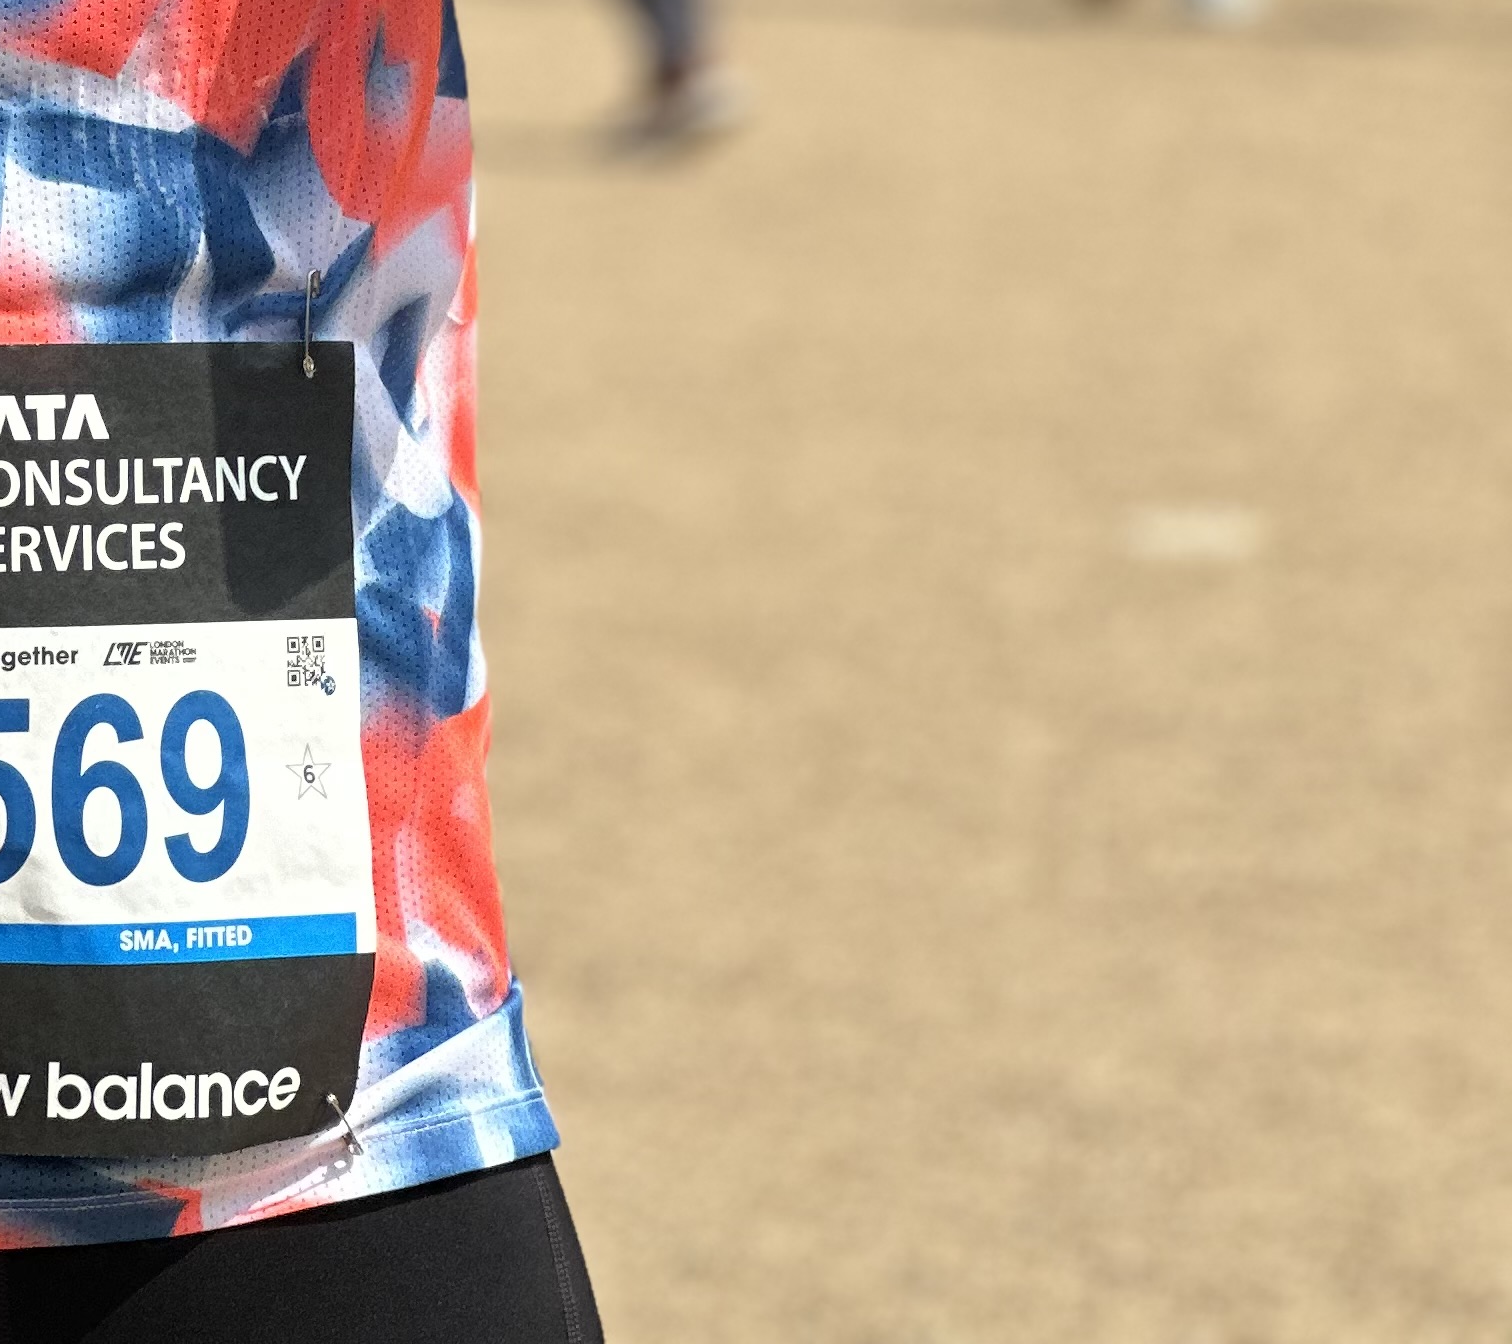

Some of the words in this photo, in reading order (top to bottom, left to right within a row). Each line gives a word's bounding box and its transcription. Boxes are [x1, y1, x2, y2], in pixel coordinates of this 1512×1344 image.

[149, 640, 184, 648] LONDON
[149, 648, 197, 657] MARATHON
[149, 656, 181, 665] EVENTS
[303, 764, 316, 784] 6
[119, 928, 180, 954] SMA,
[185, 925, 254, 951] FITTED
[46, 1065, 302, 1121] balance
